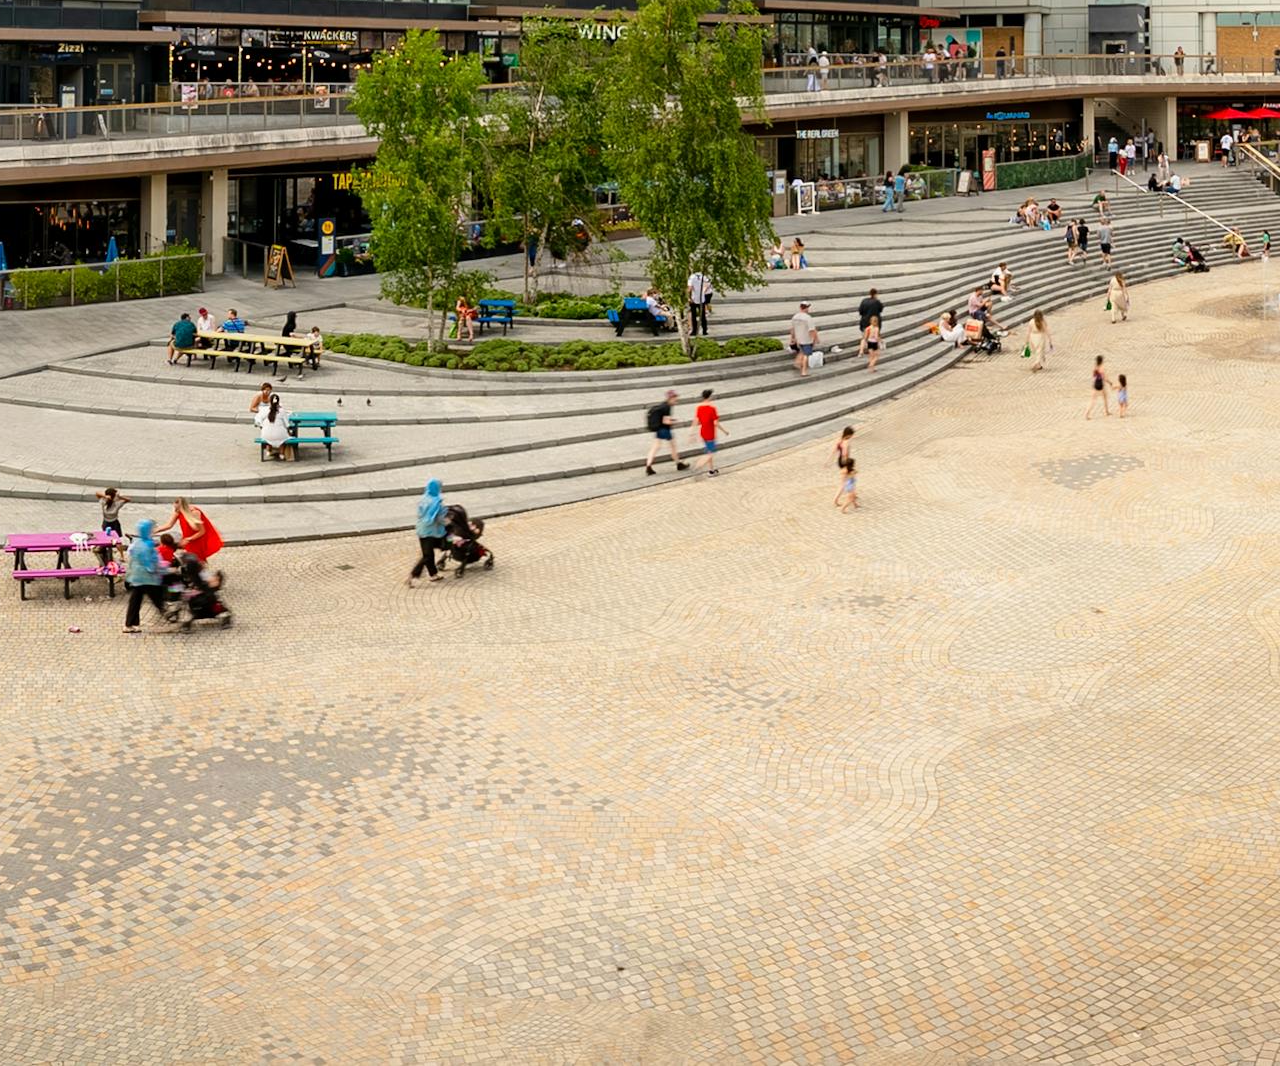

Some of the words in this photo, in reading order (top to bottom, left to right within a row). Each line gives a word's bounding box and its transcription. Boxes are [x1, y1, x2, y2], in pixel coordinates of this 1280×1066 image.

[303, 30, 358, 41] KWACKERS
[57, 43, 84, 53] Zizzi
[332, 173, 352, 191] TAP
